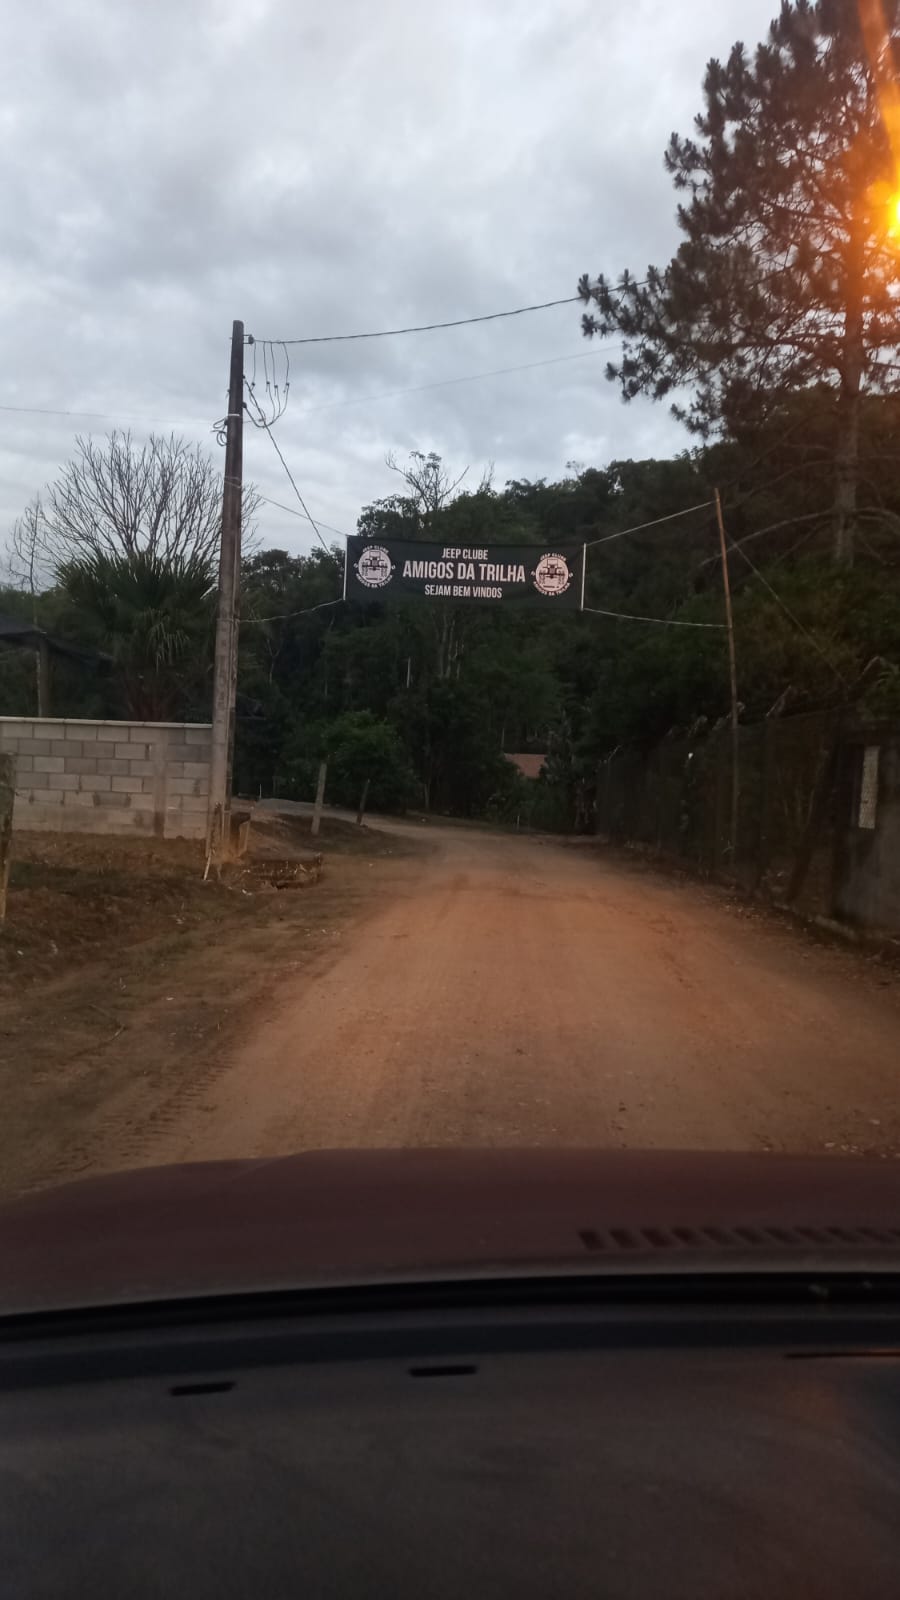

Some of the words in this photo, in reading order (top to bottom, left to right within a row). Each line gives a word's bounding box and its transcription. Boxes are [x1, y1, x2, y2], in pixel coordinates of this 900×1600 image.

[442, 548, 461, 559] JEEP
[462, 549, 488, 560] CLUBE
[402, 560, 453, 580] AMIGOS
[457, 563, 475, 580] DA
[479, 564, 526, 582] TRILHA
[424, 584, 451, 596] SEJAM
[453, 585, 470, 597] BEM
[473, 586, 502, 598] VINDOS
